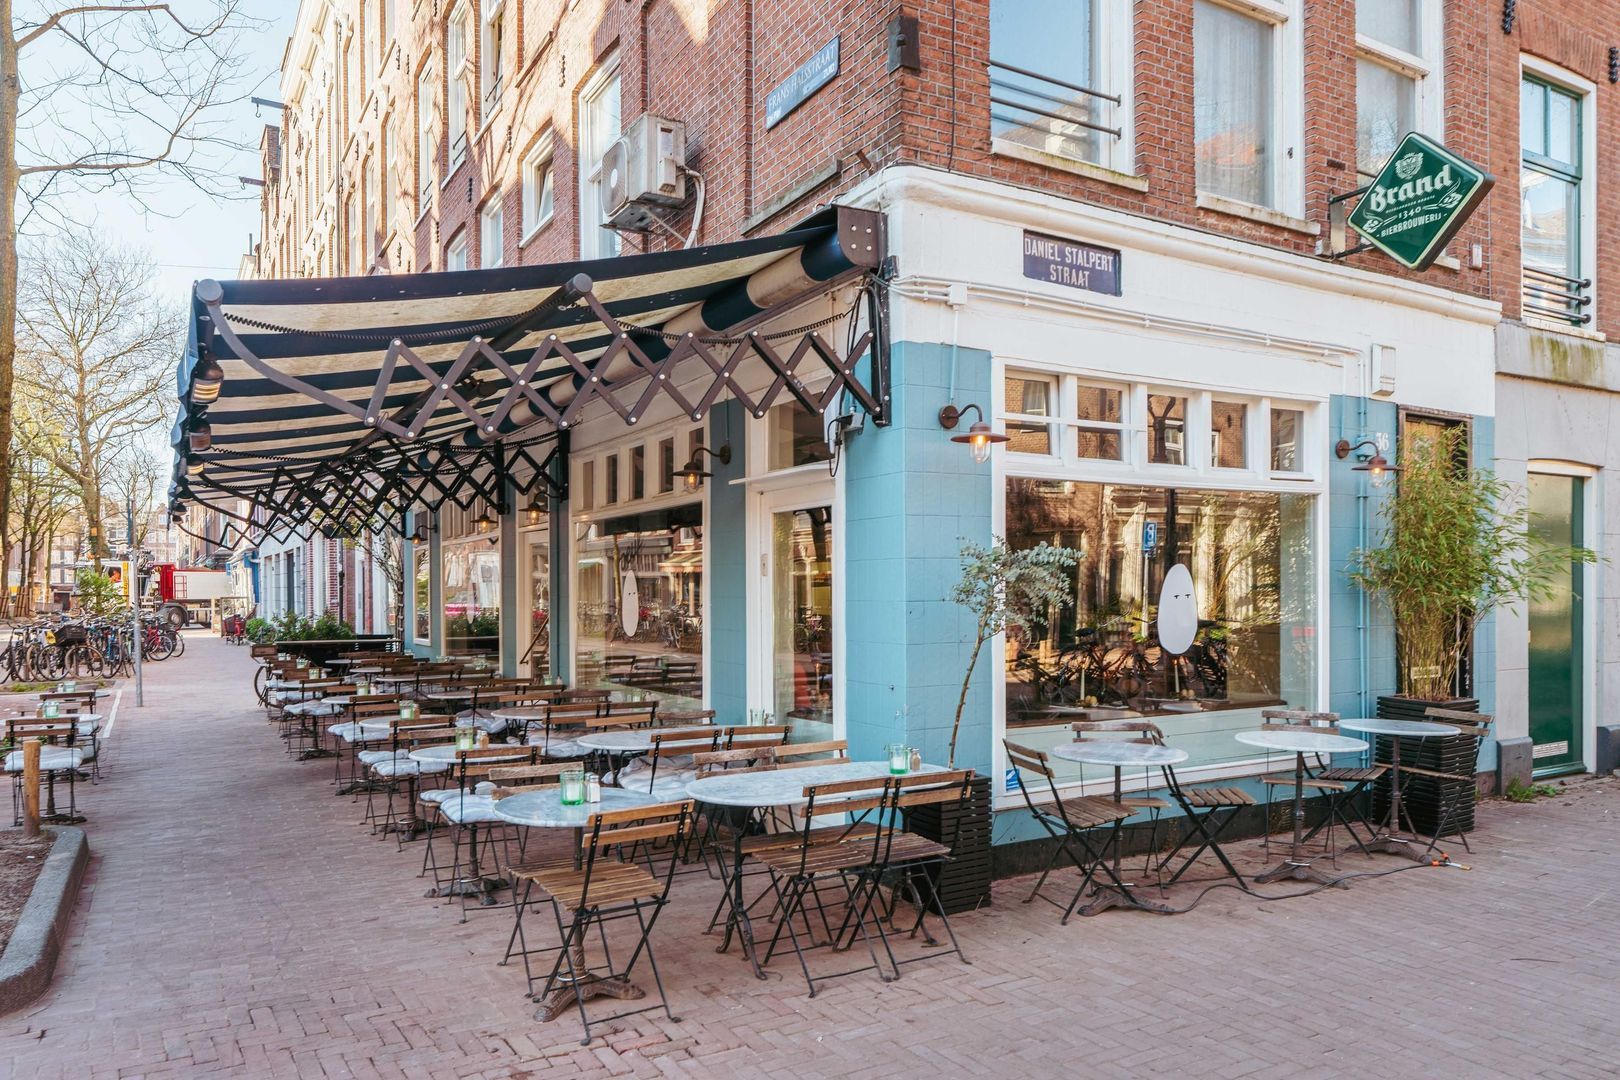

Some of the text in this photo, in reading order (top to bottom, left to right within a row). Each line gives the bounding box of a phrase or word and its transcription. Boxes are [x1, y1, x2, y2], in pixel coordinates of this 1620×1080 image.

[768, 84, 790, 111] FRANS
[1370, 164, 1453, 213] Brand
[1380, 212, 1442, 238] BIERBROUWERIJ
[1398, 205, 1422, 219] 1340
[1024, 238, 1114, 272] DANIEL STALPERT
[1050, 264, 1090, 287] STRAAT
